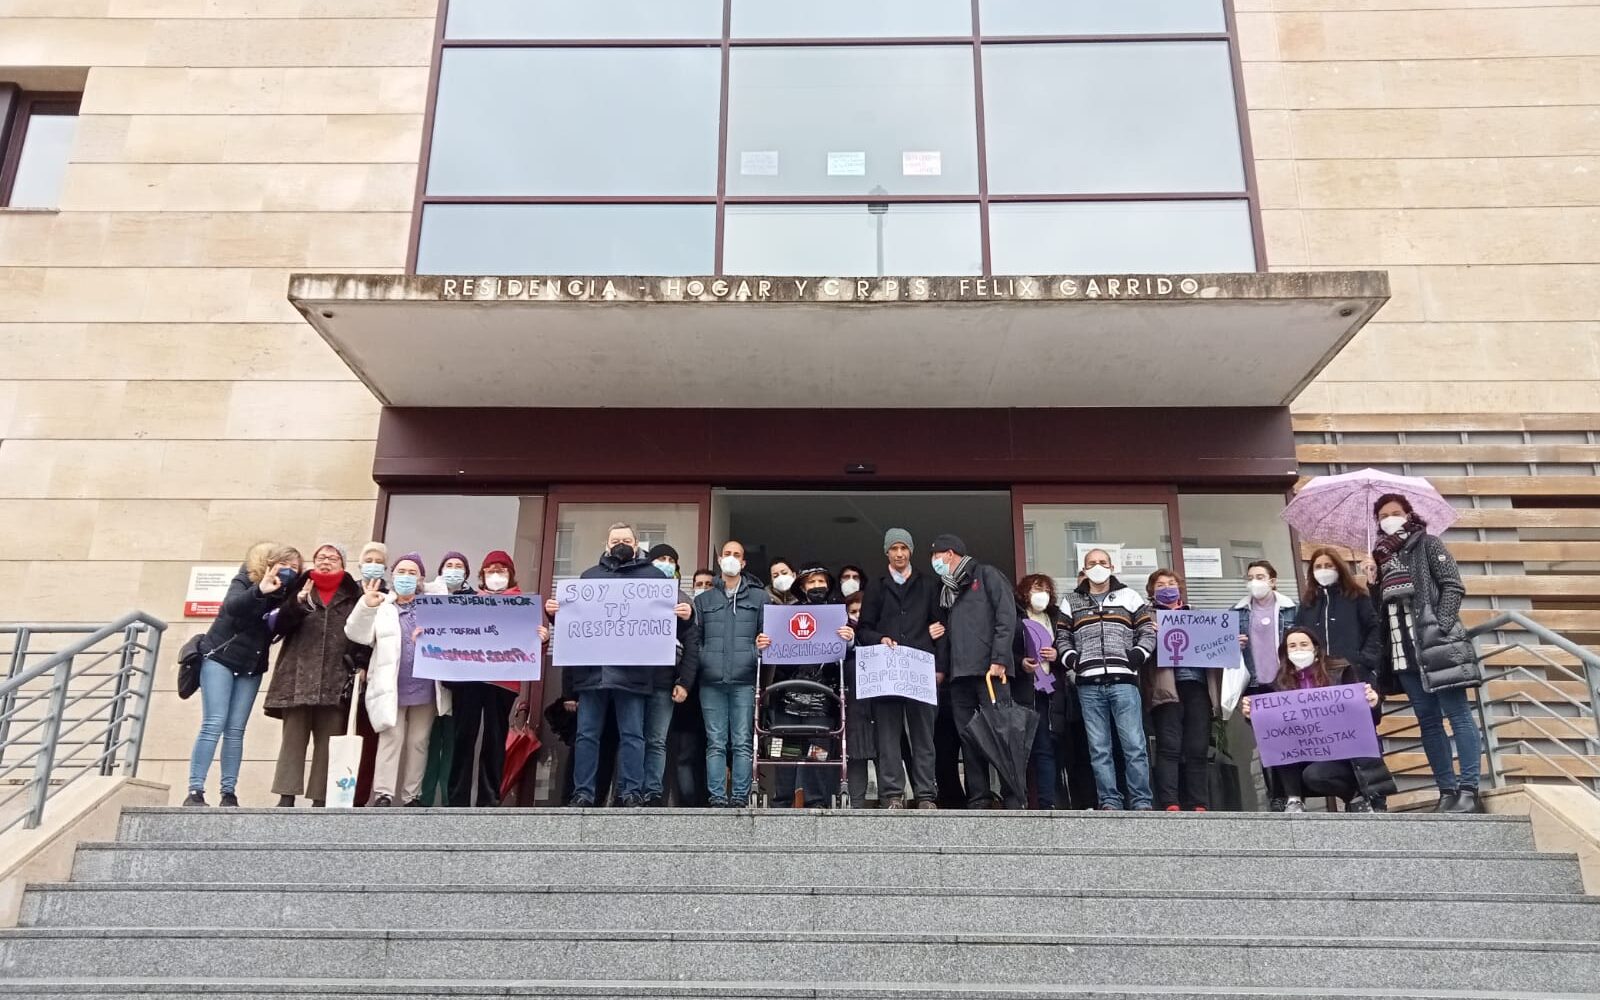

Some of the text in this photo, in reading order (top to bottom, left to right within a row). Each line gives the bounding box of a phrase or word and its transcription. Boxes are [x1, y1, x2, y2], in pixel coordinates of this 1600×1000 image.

[444, 278, 618, 297] RESIDENCIA
[666, 279, 772, 298] HOGAR
[794, 279, 807, 297] Y
[959, 278, 1034, 297] FELIX
[1059, 277, 1199, 296] GARRIDO
[565, 582, 674, 602] SOY COMO
[1161, 613, 1229, 629] MARTXOAK 8
[424, 627, 435, 636] NO
[766, 641, 843, 659] MACHISMO
[1194, 634, 1235, 653] EGUNERO
[1255, 688, 1354, 710] FELIX GARRIDO
[1283, 711, 1297, 722] EZ
[1263, 721, 1324, 740] JOKABIDE
[1298, 730, 1357, 747] MATXISTAK
[1281, 746, 1332, 761] JASATEN
